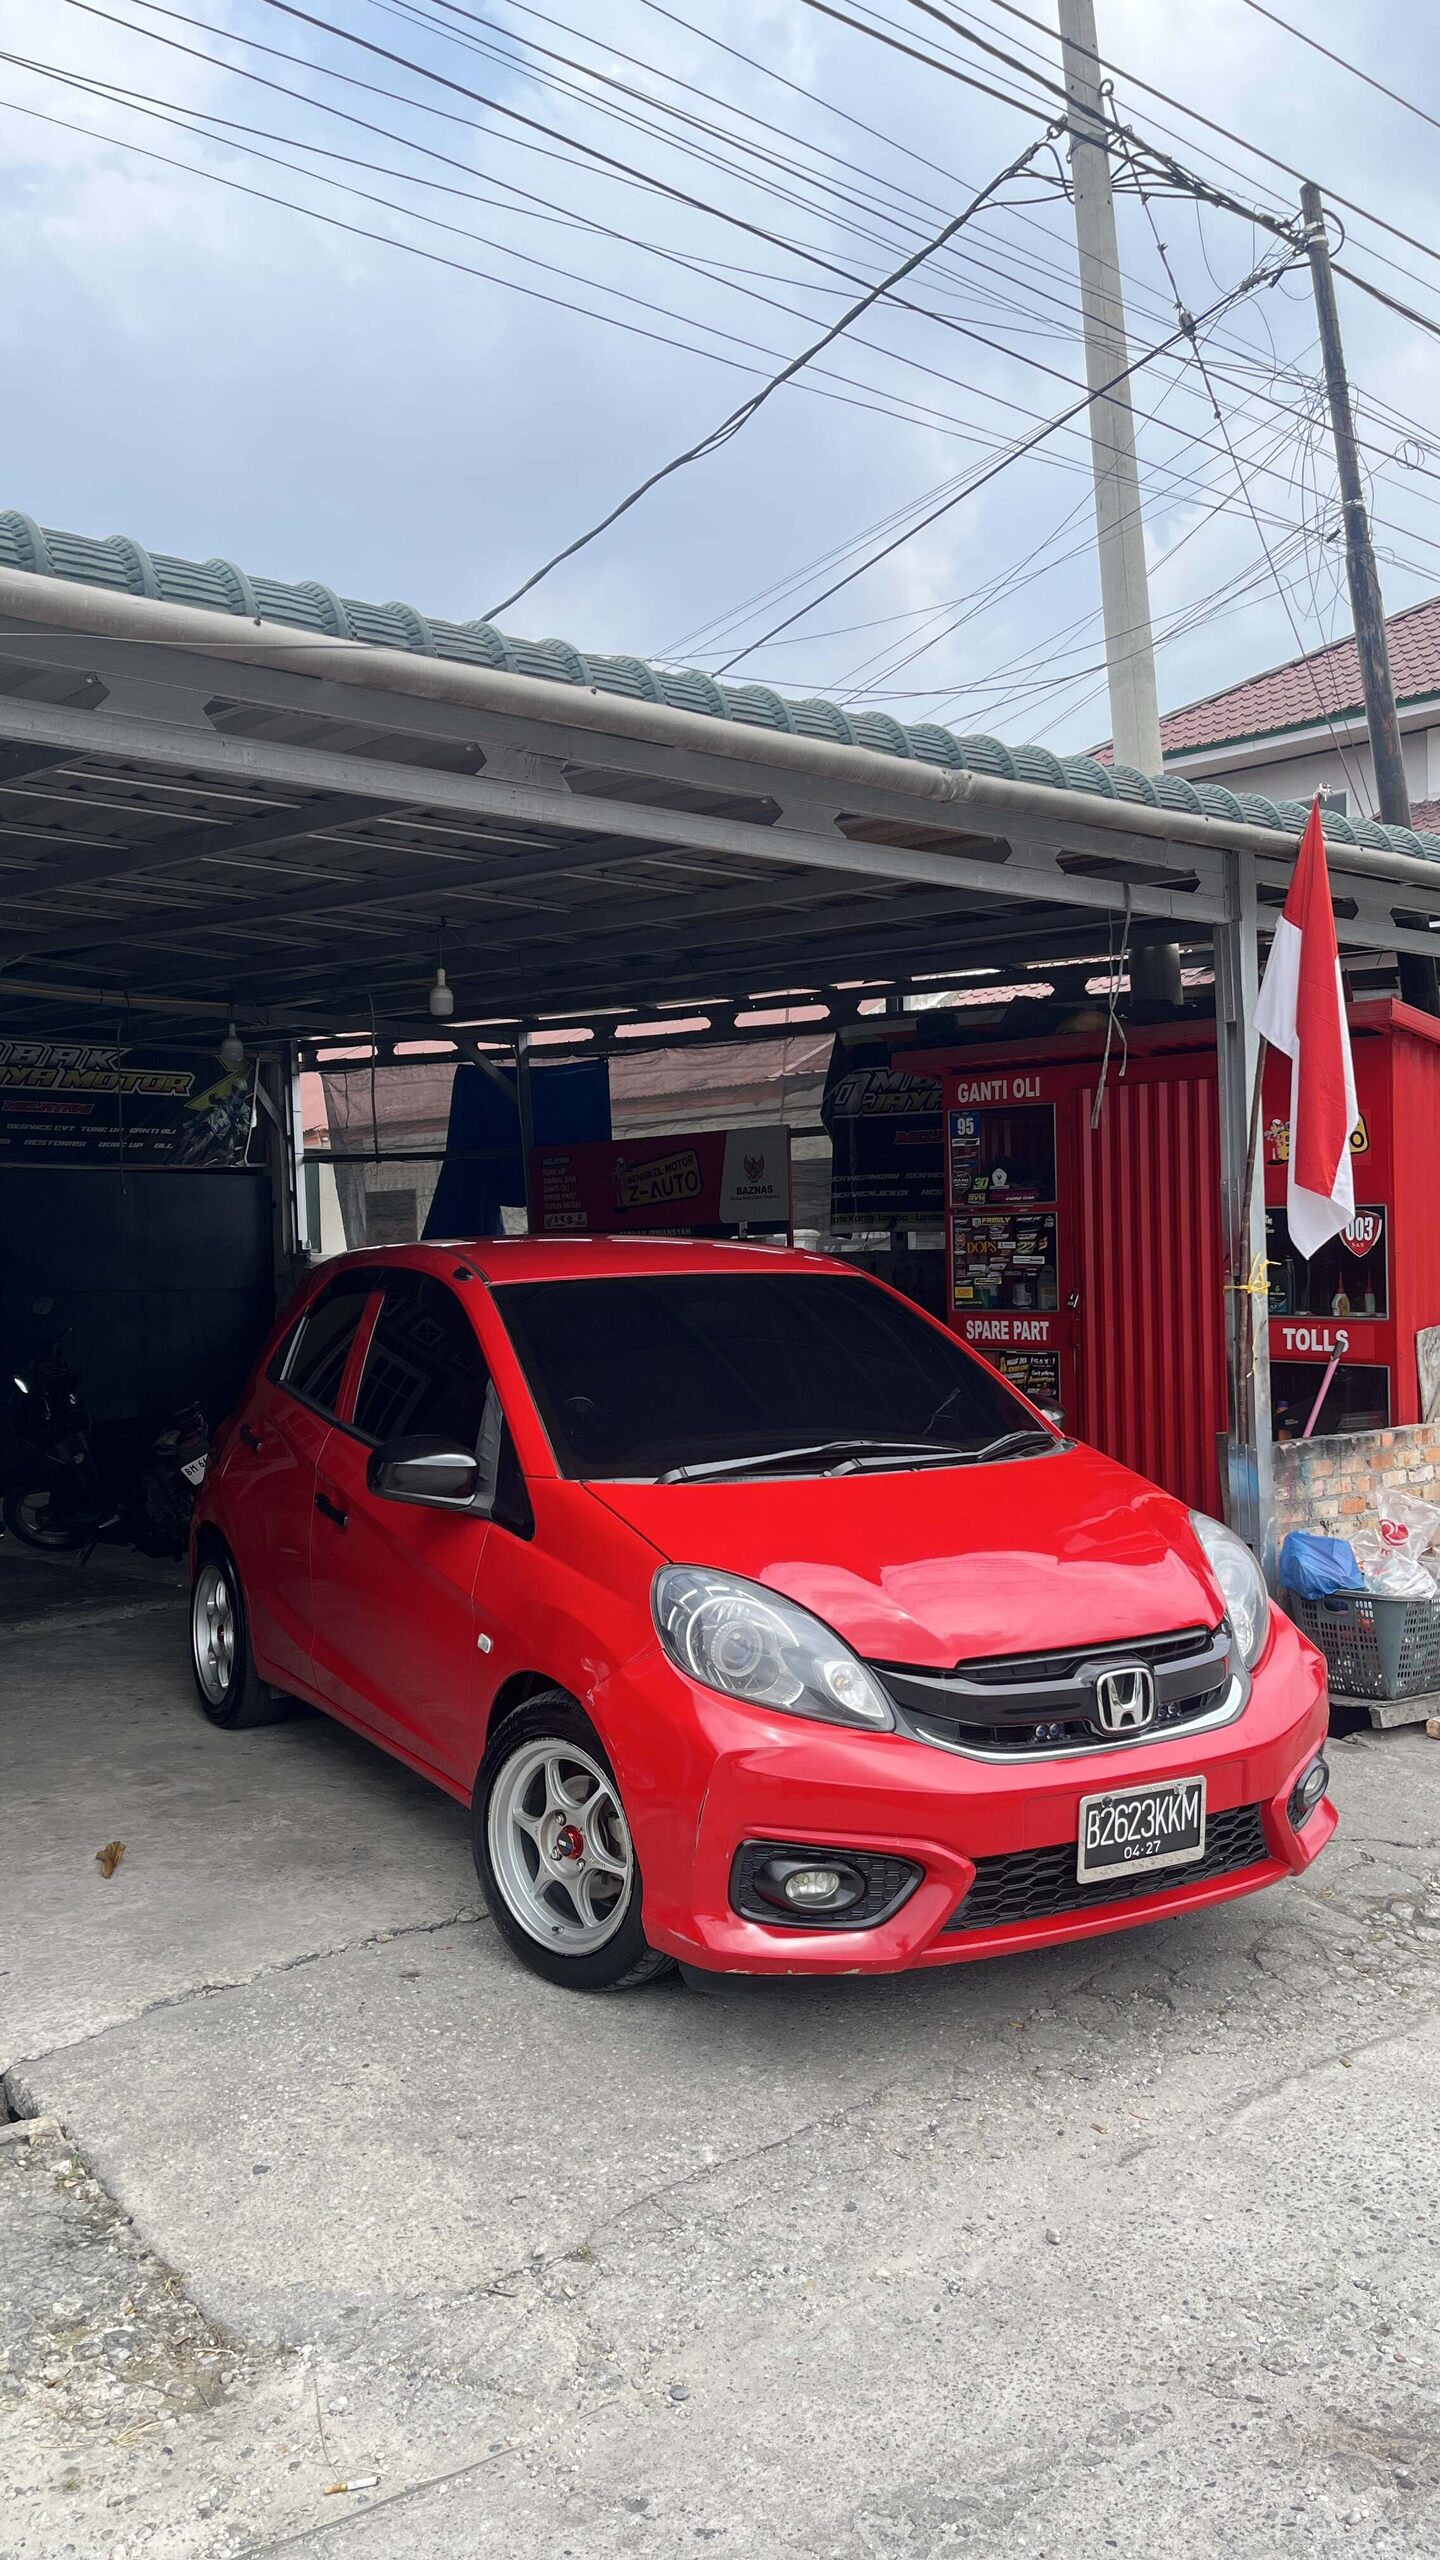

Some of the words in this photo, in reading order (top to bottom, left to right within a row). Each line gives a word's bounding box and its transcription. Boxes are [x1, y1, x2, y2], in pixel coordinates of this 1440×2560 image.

[0, 1042, 122, 1070] BAK
[60, 1069, 188, 1095] MOTOR
[957, 1079, 1008, 1103] GANTI
[1013, 1076, 1041, 1099] OLI
[6, 1123, 53, 1132] SERVICE
[54, 1124, 76, 1132] CVT
[129, 1127, 160, 1135] GANTI
[956, 1117, 975, 1136] 95
[128, 1141, 145, 1149] UP
[627, 1167, 664, 1186] BENGKEL
[664, 1155, 694, 1174] MOTOR
[628, 1171, 698, 1203] Z-AUTO
[736, 1184, 774, 1196] BAZNAS
[982, 1216, 1011, 1226] FAMILY
[967, 1240, 997, 1254] DOPS
[966, 1319, 1010, 1340] SPARE
[1013, 1320, 1050, 1341] PART
[1282, 1327, 1350, 1353] TOLLS
[184, 1464, 199, 1476] BM
[1086, 1790, 1199, 1849] B2623KKM
